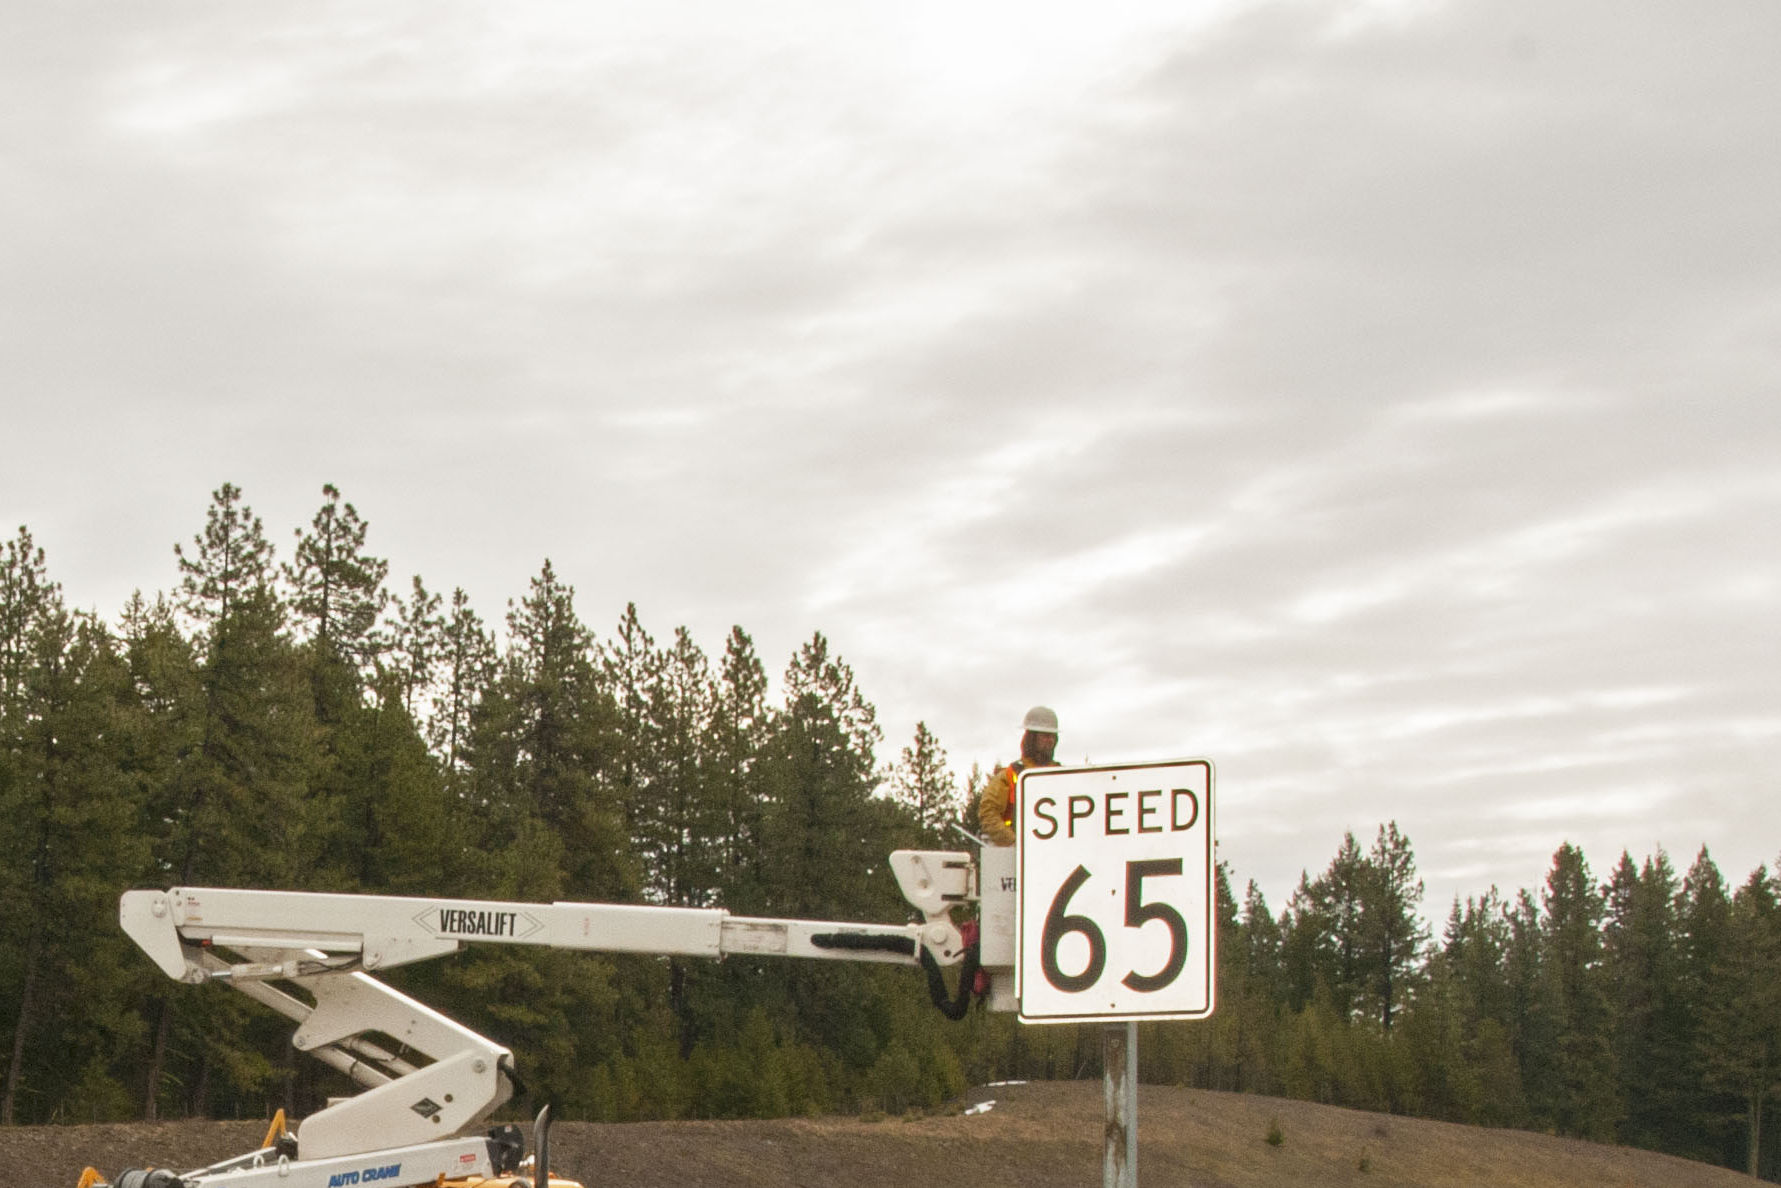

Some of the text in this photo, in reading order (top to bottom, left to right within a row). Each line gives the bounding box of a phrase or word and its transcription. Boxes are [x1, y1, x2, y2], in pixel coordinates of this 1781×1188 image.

[1032, 788, 1199, 840] SPEED
[439, 908, 517, 937] VERSALIFT
[1040, 857, 1189, 994] 65
[327, 1162, 402, 1188] AUTO CRANE
